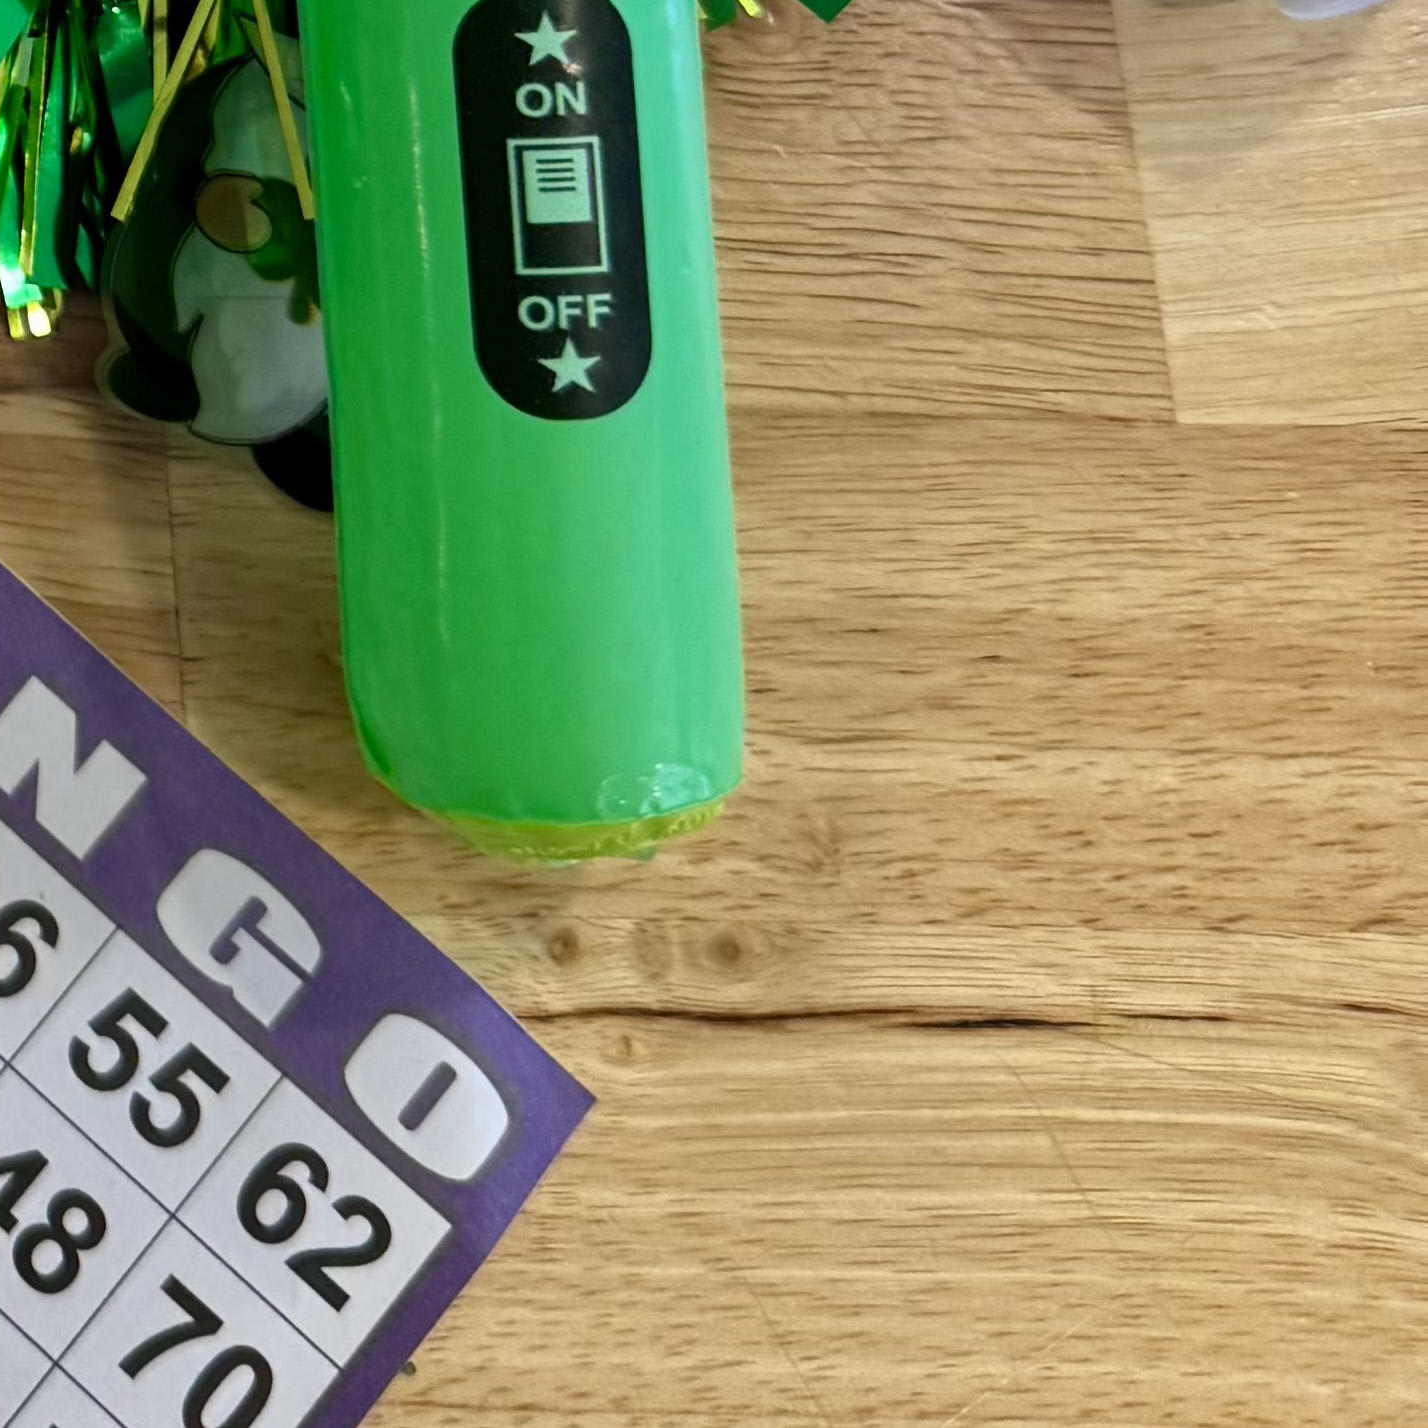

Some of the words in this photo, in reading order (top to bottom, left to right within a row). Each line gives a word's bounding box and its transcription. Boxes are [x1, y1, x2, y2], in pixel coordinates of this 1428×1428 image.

[515, 80, 587, 117] ON
[517, 292, 612, 331] OFF
[69, 988, 231, 1149] 55
[237, 1142, 393, 1313] 62
[118, 1274, 275, 1428] 70
